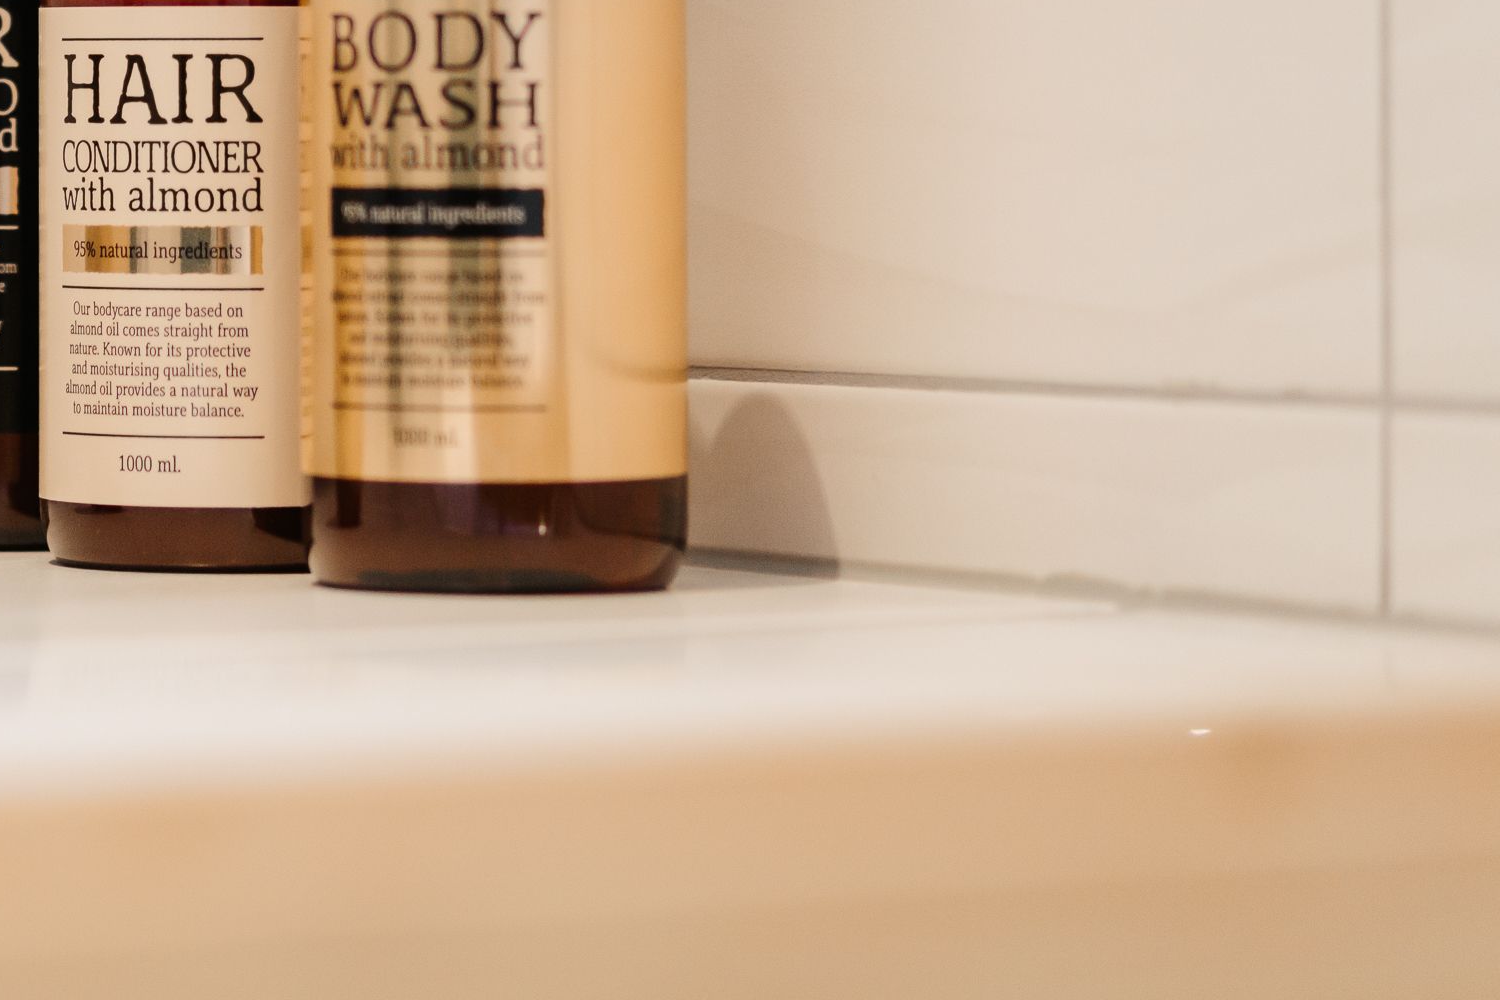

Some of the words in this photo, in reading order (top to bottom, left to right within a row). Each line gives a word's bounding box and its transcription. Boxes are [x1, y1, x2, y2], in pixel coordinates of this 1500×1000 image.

[331, 10, 541, 73] BODY
[63, 53, 264, 125] HAIR
[332, 79, 539, 131] WASH
[62, 139, 264, 174] CONDITIONER
[401, 134, 545, 170] almond
[62, 176, 116, 212] with
[128, 176, 264, 212] almond
[427, 202, 526, 229] ingredients
[73, 240, 97, 258] 95%
[99, 241, 148, 259] natural
[153, 241, 243, 263] ingredients
[73, 300, 90, 316] Our
[93, 301, 142, 320] bodycare
[145, 305, 181, 321] range
[184, 302, 222, 318] based
[226, 305, 244, 318] on
[70, 321, 103, 336] almond
[106, 321, 119, 337] oil
[122, 325, 160, 338] comes
[163, 322, 213, 341] straight
[217, 323, 249, 338] from
[69, 341, 100, 356] nature.
[102, 341, 141, 357] Known
[145, 342, 163, 357] for
[166, 342, 182, 357] its
[186, 343, 251, 361] protective
[72, 361, 88, 376] and
[90, 361, 159, 381] moisturising
[163, 363, 222, 380] qualities,
[225, 362, 247, 378] the
[65, 379, 97, 395] almond
[99, 380, 113, 396] oil
[116, 381, 166, 400] provides
[169, 386, 177, 397] a
[180, 382, 228, 398] natural
[233, 386, 259, 401] way
[73, 401, 82, 414] to
[83, 400, 128, 416] maintain
[132, 402, 187, 417] moisture
[191, 402, 245, 417] balance.
[119, 455, 153, 472] 1000
[158, 455, 181, 473] ml.
